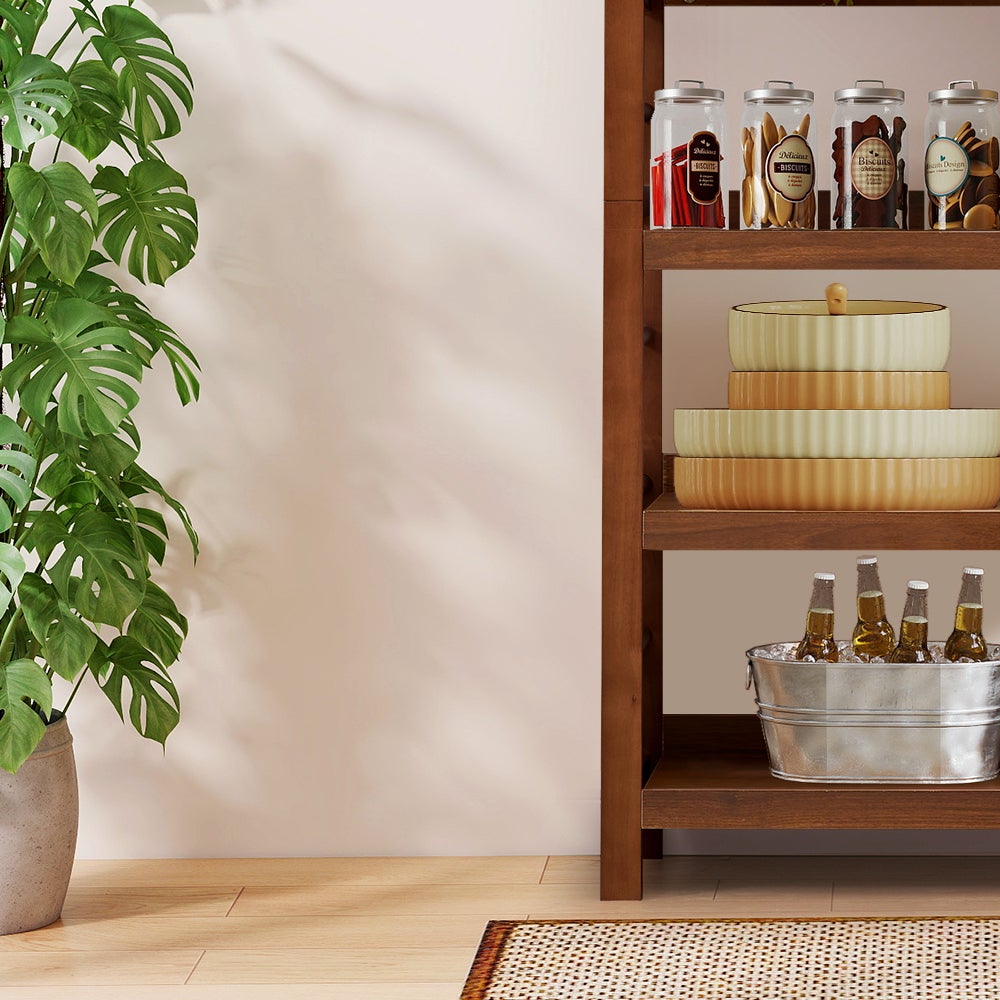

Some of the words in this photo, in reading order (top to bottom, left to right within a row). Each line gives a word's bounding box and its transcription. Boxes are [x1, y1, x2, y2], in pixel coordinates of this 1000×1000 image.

[858, 156, 891, 166] Biscuits
[695, 162, 716, 170] BISCUITS
[780, 163, 808, 172] BISCUITS
